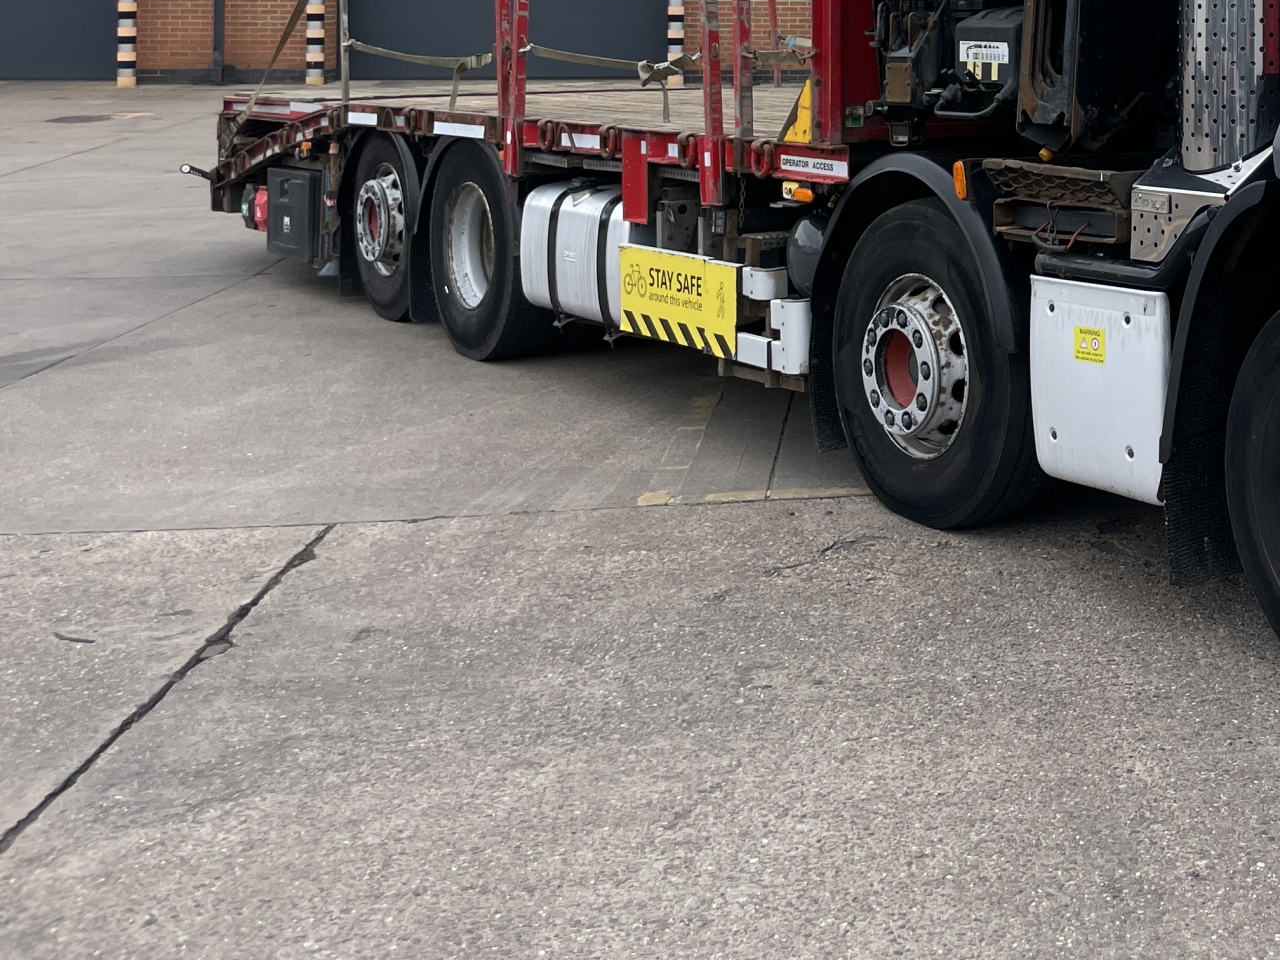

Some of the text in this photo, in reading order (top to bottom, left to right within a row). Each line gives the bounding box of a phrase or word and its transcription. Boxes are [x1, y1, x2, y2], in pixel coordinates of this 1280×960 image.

[782, 158, 834, 172] OPERATOR ACCESS
[648, 267, 703, 297] STAY SAFE
[648, 292, 703, 312] around this vehicle
